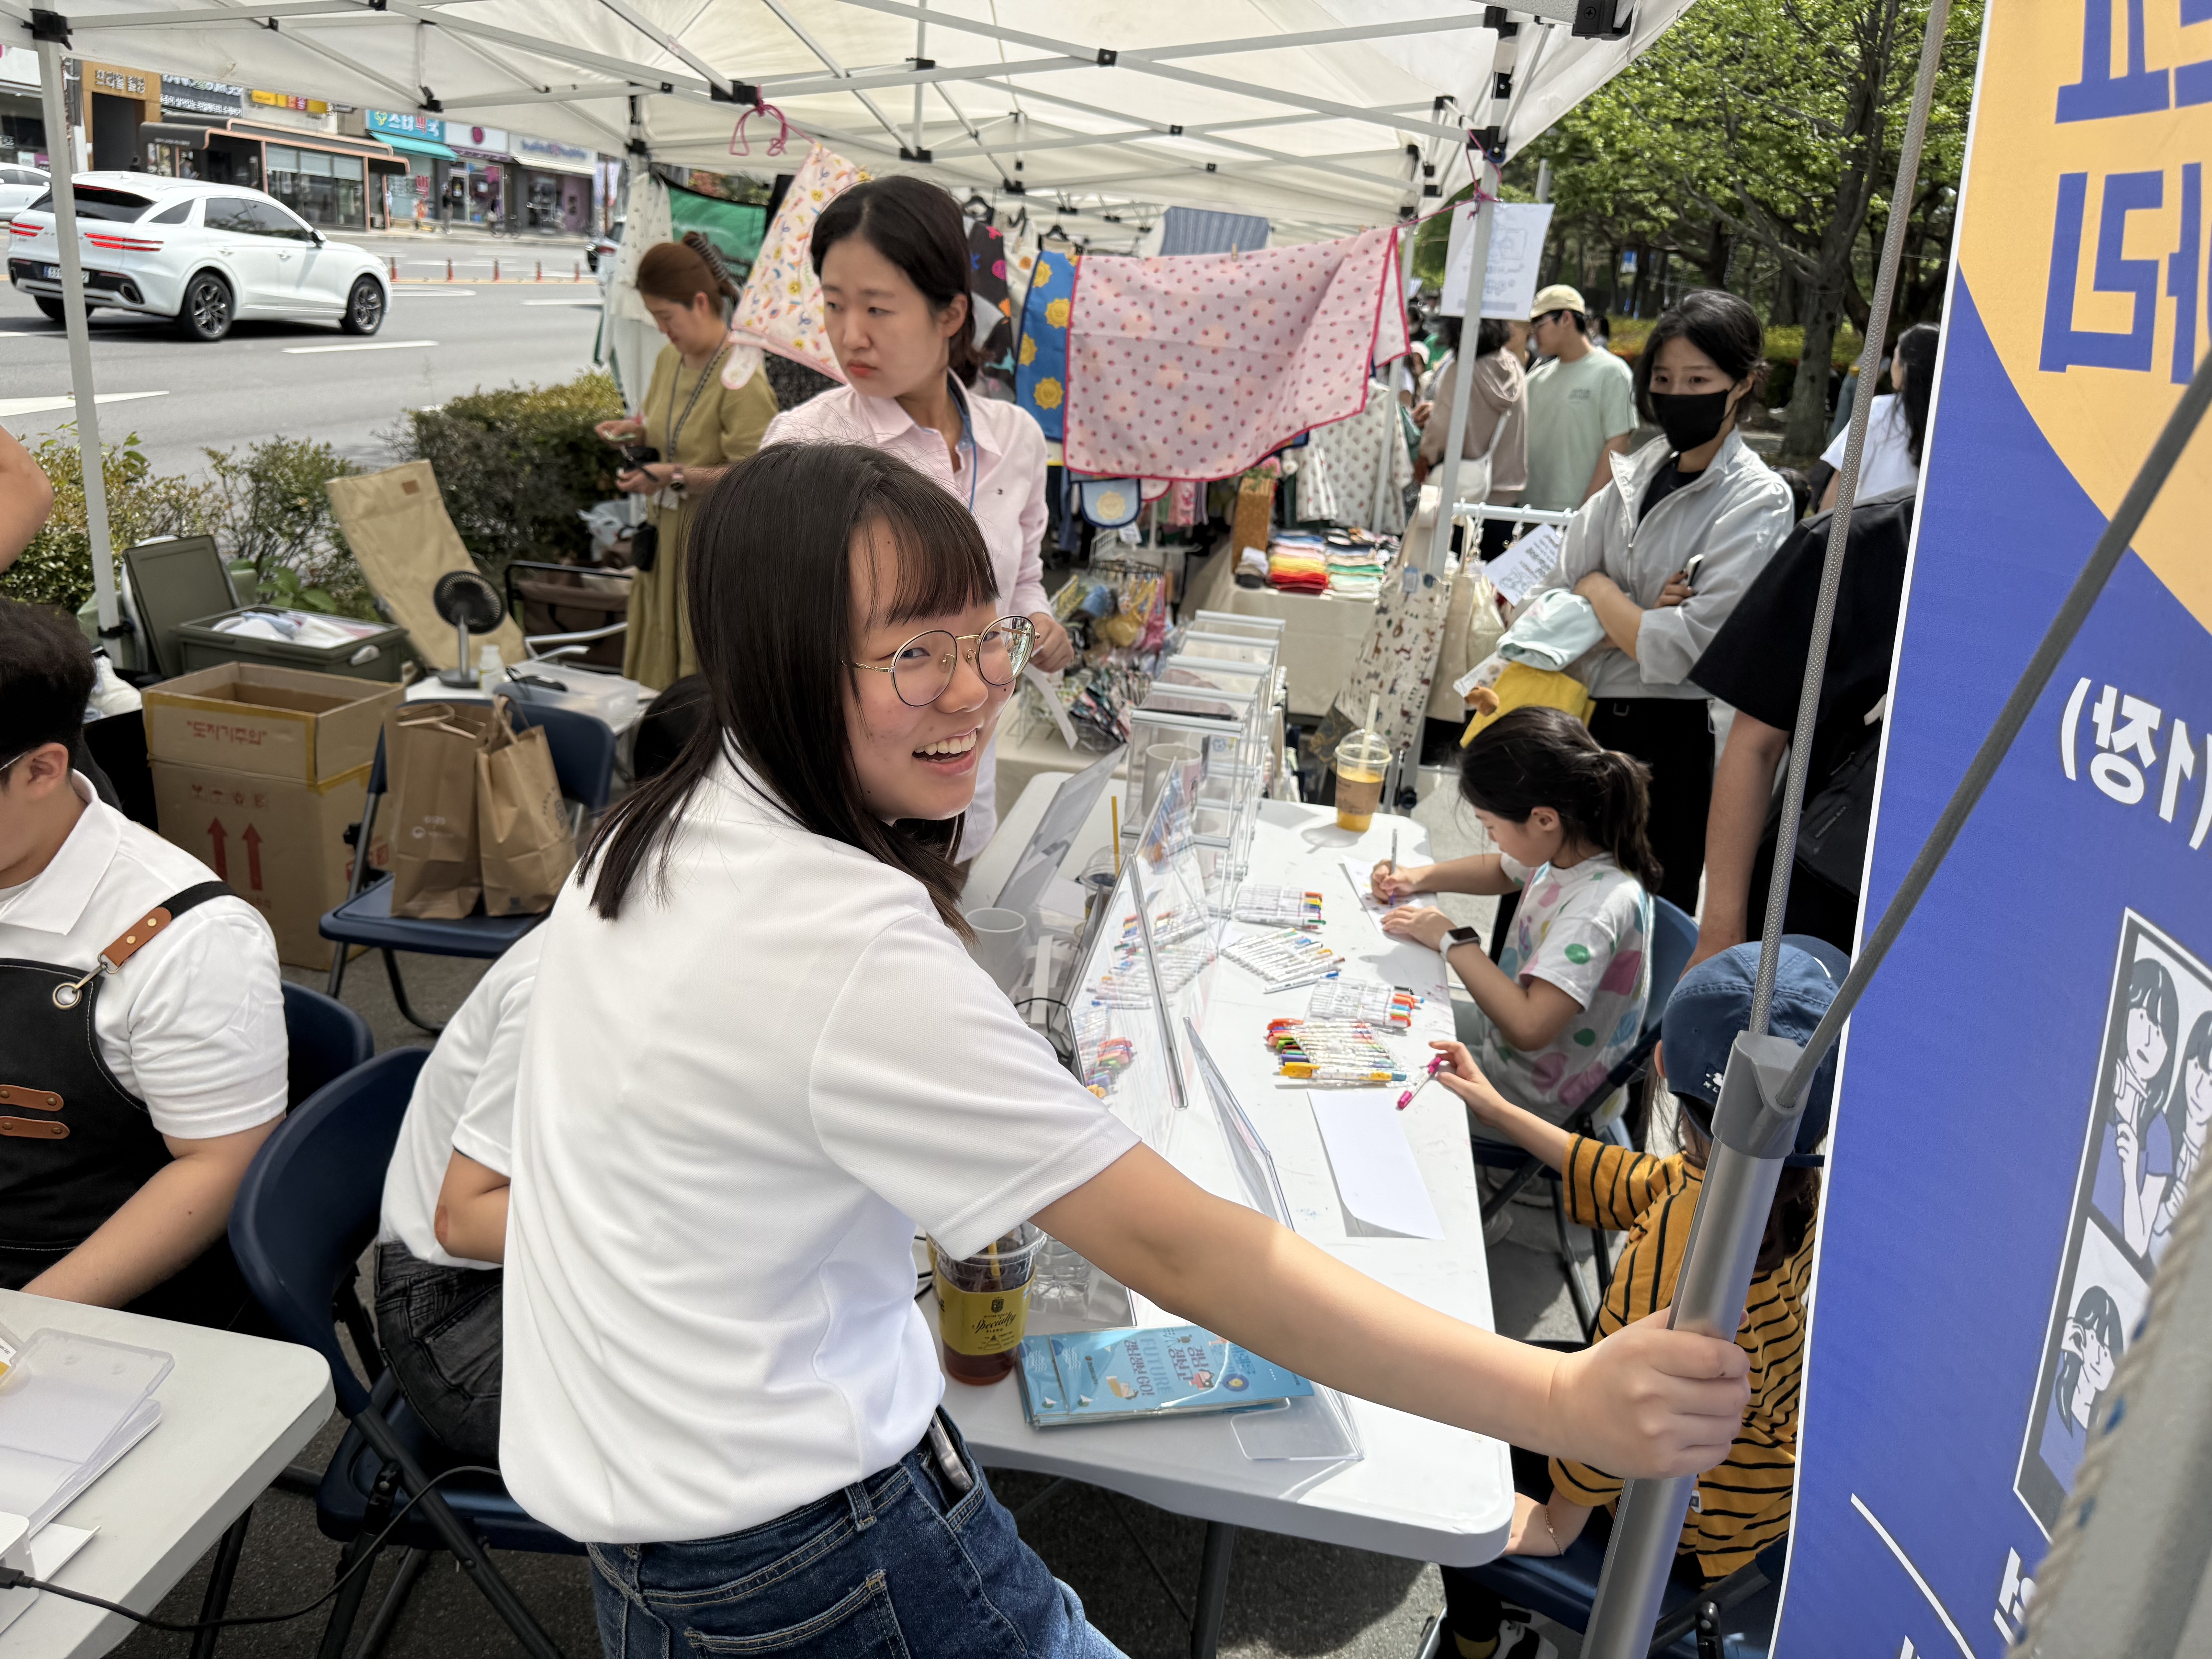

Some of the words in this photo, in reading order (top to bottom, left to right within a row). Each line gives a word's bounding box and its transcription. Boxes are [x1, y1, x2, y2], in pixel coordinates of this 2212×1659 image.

[972, 1311, 1016, 1334] Specialty
[1124, 1340, 1147, 1374] 경남정보
[1136, 1376, 1155, 1395] GO!
[1140, 1338, 1173, 1394] FUTURE
[1168, 1347, 1194, 1381] 정보고
[1187, 1345, 1209, 1367] 경남
